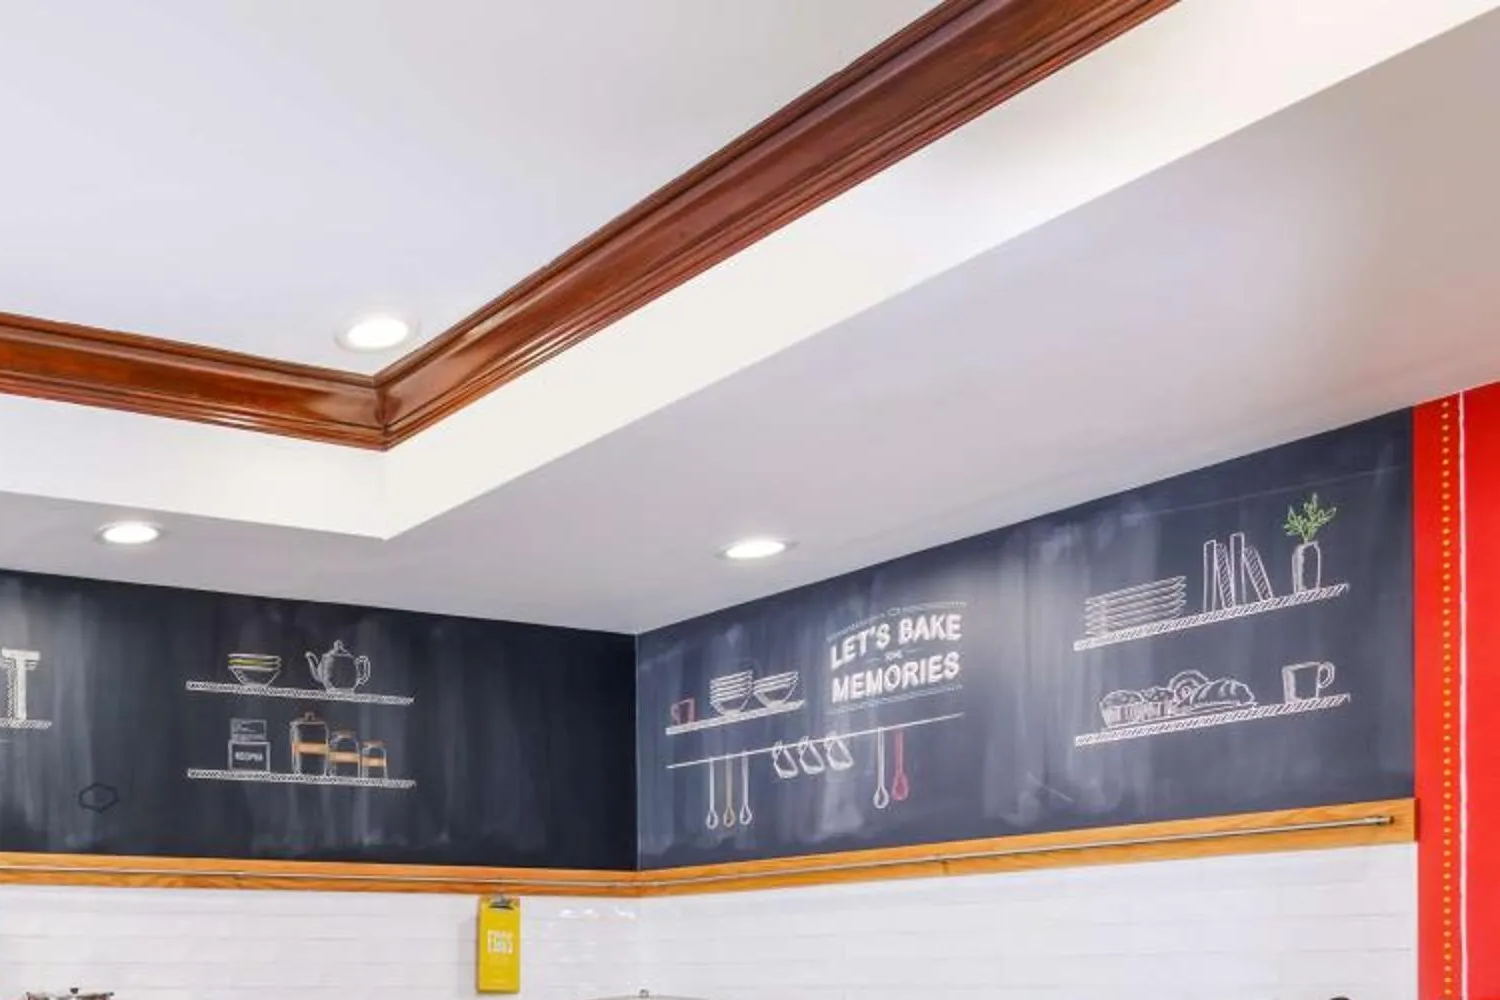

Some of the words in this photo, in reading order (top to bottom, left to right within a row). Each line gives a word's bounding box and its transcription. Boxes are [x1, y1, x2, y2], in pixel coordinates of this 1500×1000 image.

[830, 622, 891, 670] LET'S
[898, 614, 962, 645] BAKE
[832, 651, 960, 704] MEMORIES
